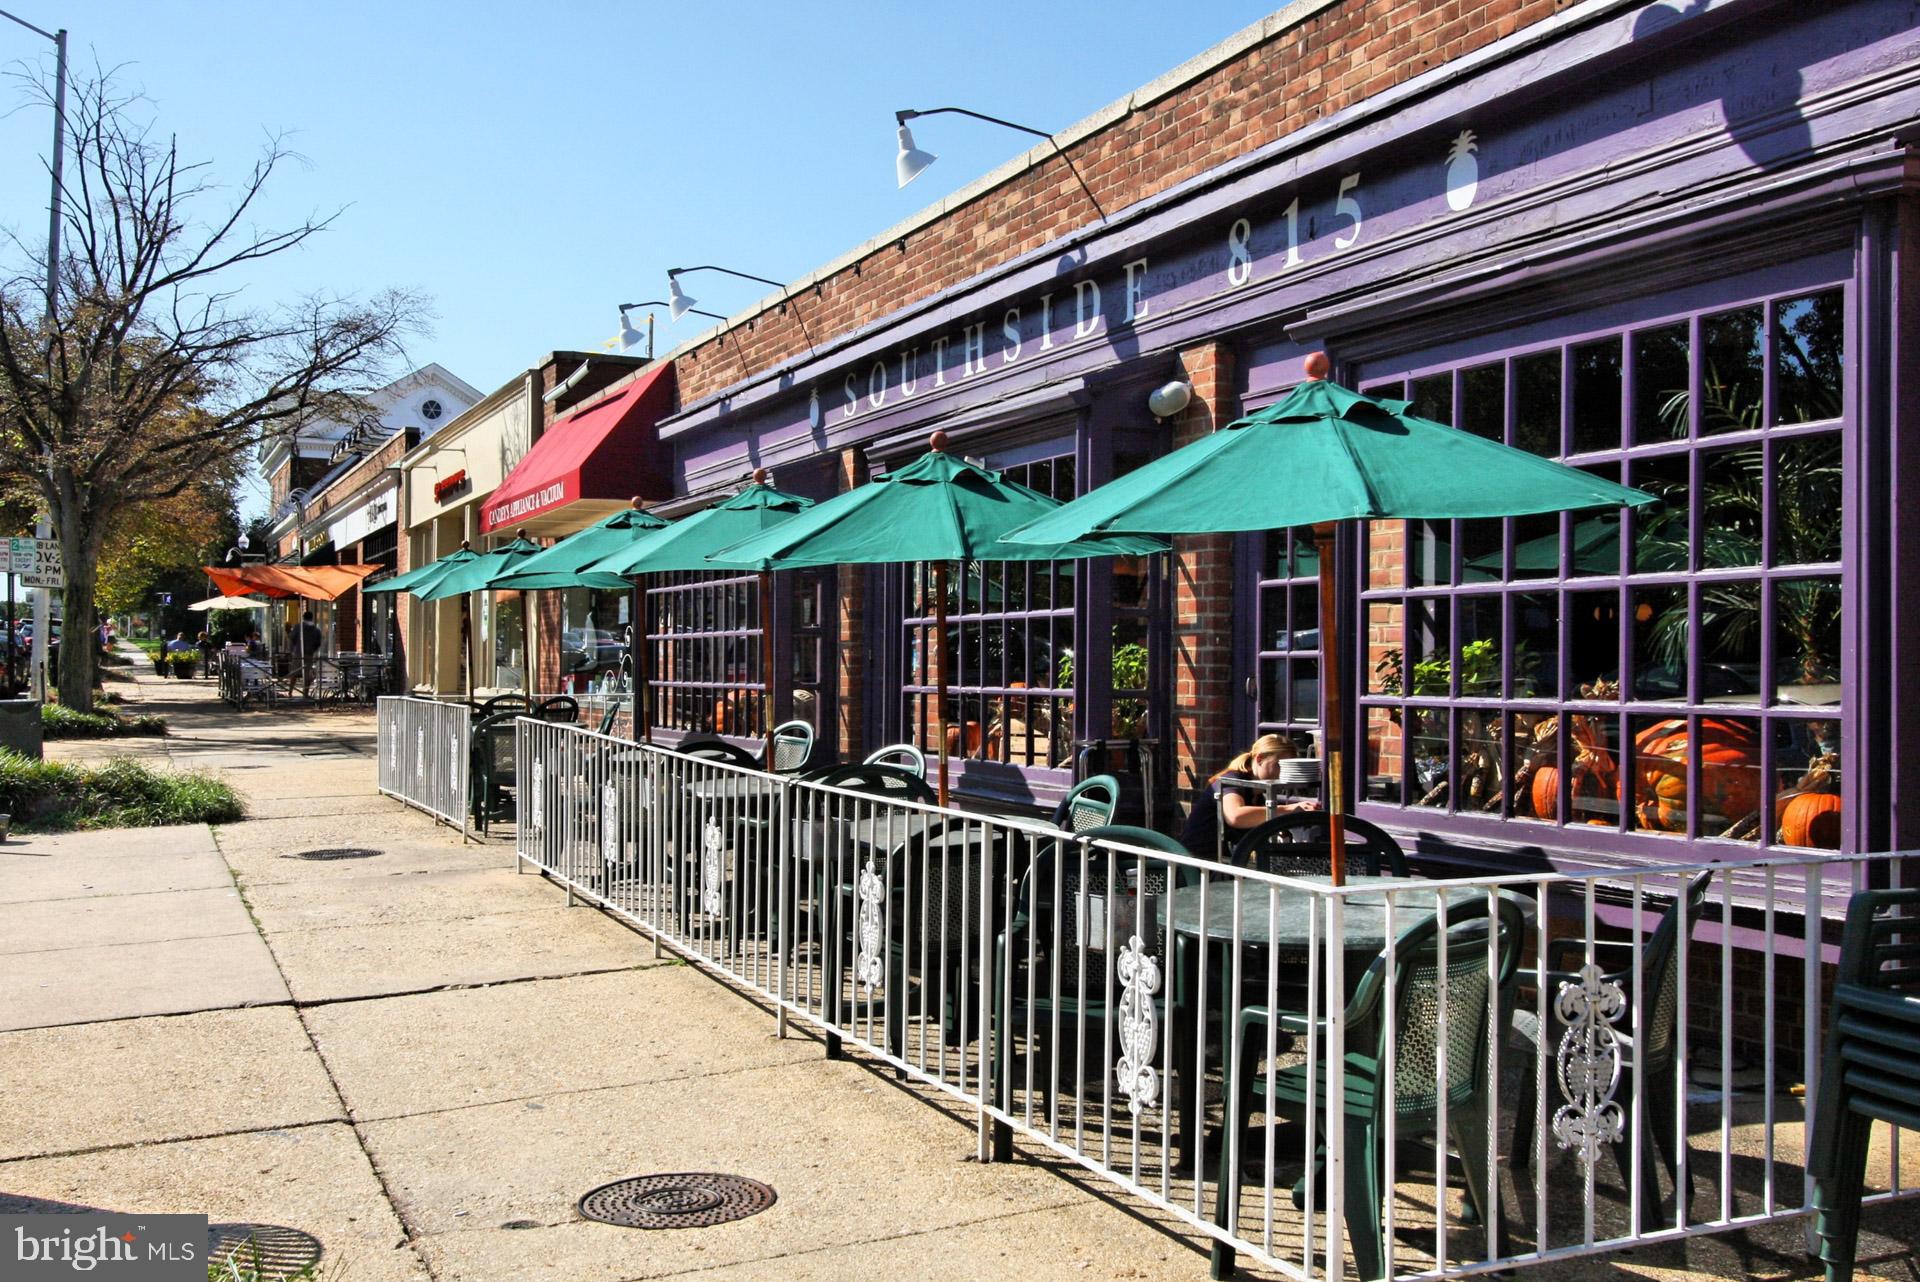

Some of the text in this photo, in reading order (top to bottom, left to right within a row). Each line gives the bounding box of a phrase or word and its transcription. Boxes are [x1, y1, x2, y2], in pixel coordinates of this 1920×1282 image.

[842, 172, 1363, 418] SOUTHSIDE 815
[510, 494, 535, 517] APPLIANCE
[540, 482, 564, 506] VACUUM
[12, 540, 19, 550] 2
[45, 566, 61, 575] PM
